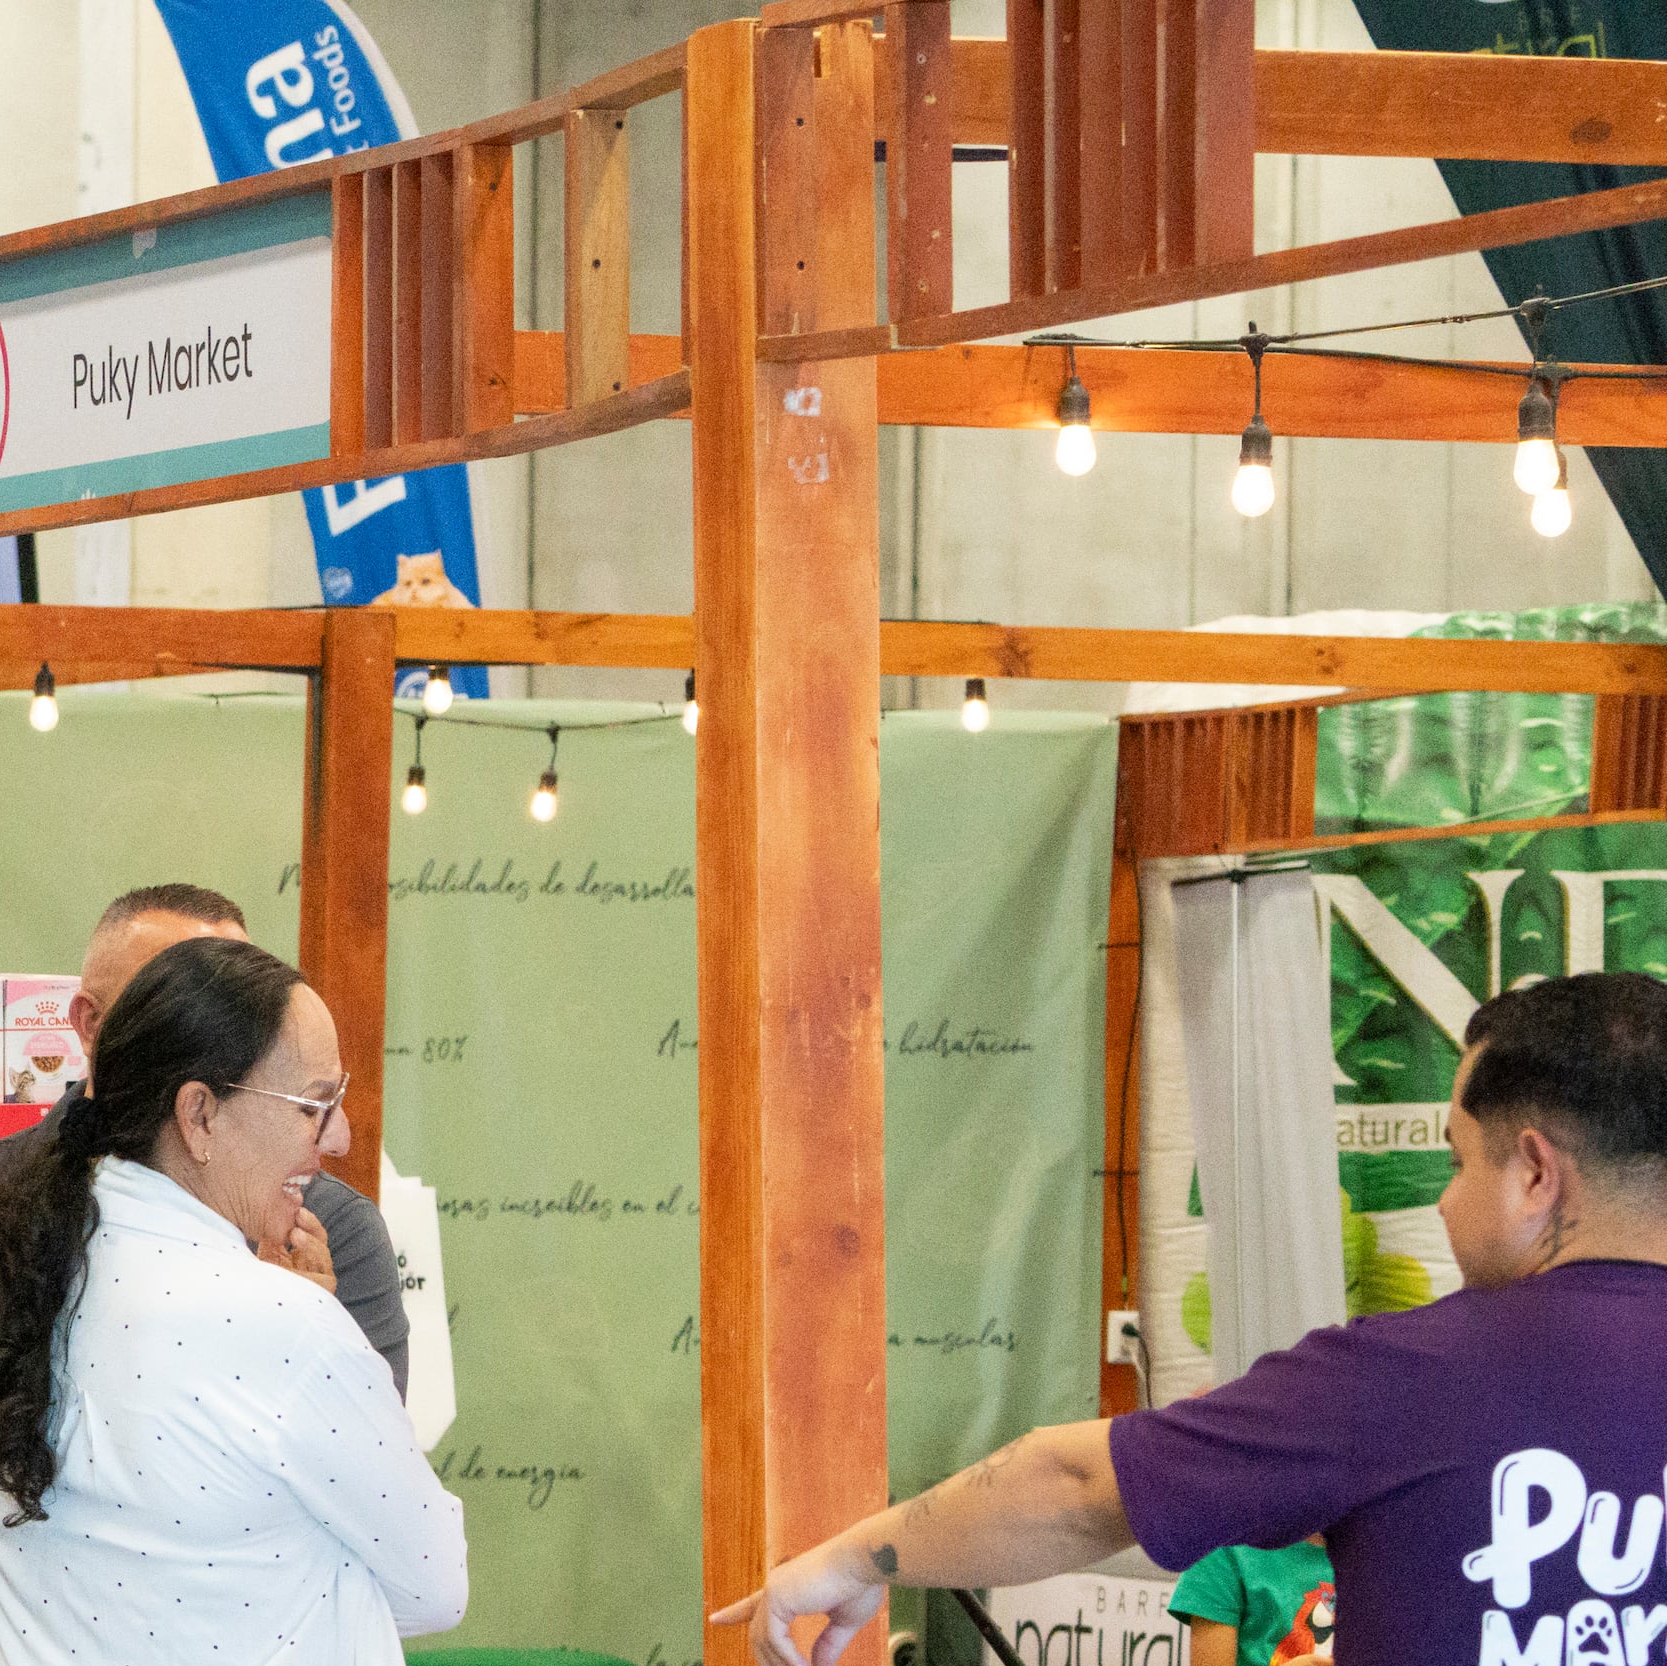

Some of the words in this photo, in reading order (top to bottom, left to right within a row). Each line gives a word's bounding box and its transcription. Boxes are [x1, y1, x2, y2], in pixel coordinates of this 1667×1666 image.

[311, 24, 362, 137] Foods
[73, 344, 139, 420] Puky
[148, 322, 253, 396] Market
[15, 1016, 46, 1027] ROYAL
[1461, 1448, 1667, 1609] Pu
